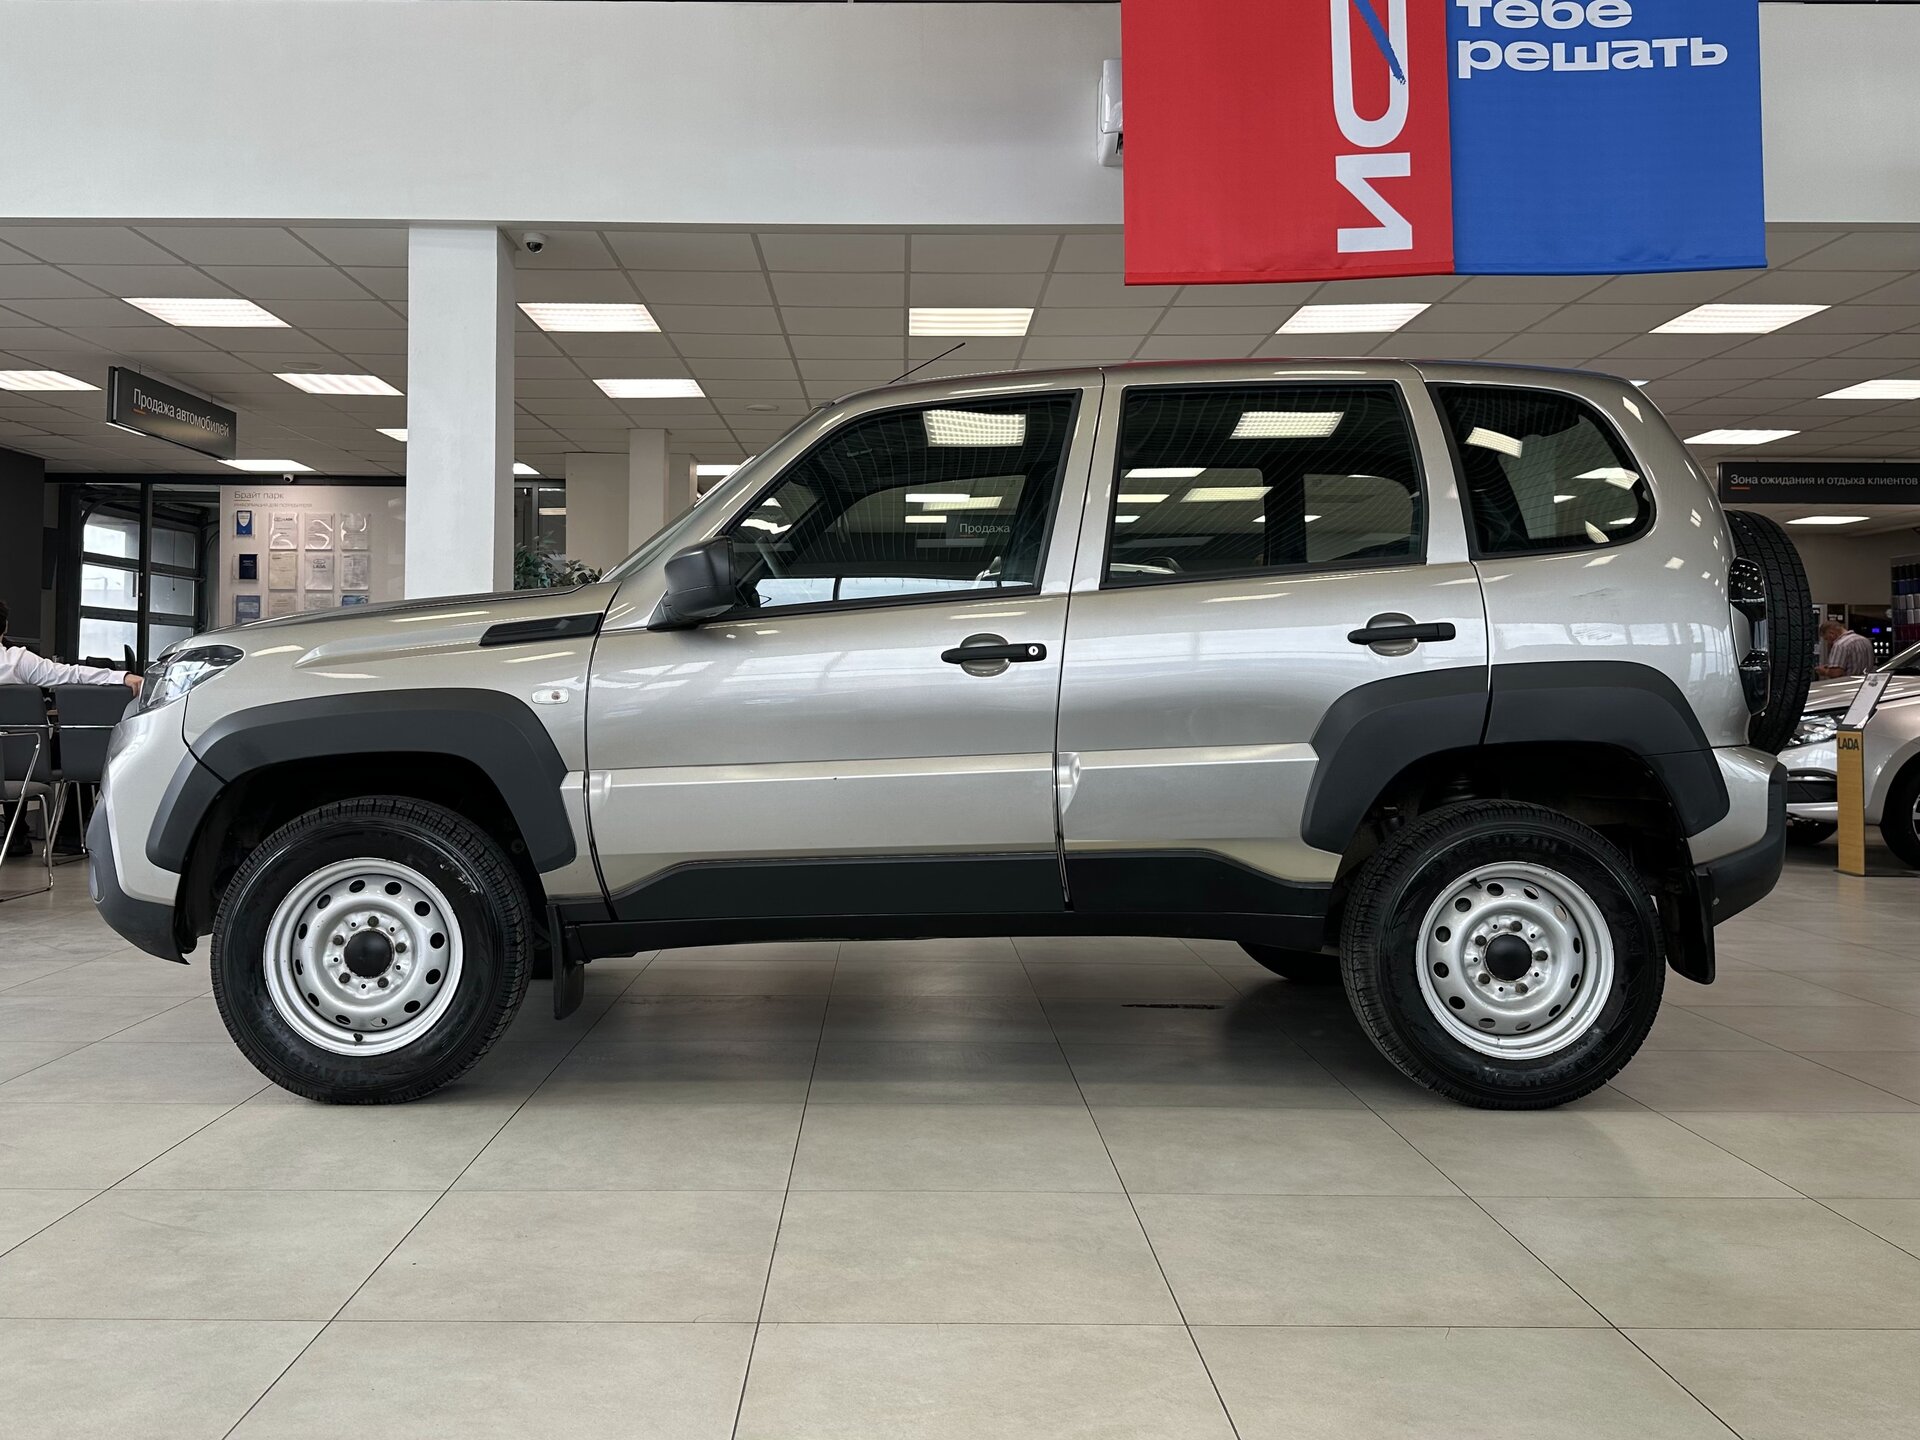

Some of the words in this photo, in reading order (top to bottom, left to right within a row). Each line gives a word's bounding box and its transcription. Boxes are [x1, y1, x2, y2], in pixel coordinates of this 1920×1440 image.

[1456, 0, 1633, 30] тебе
[1457, 37, 1729, 79] решать
[133, 387, 175, 418] Продажа
[176, 408, 230, 438] автомобилей
[1730, 474, 1759, 485] Зона
[1760, 476, 1815, 486] ожидания
[1817, 476, 1825, 485] и
[1826, 476, 1866, 486] отдыха
[1868, 476, 1919, 486] клиентов
[234, 490, 261, 500] Брайт
[263, 492, 285, 500] парк
[959, 523, 1010, 534] Продажа
[1838, 737, 1859, 751] LADA
